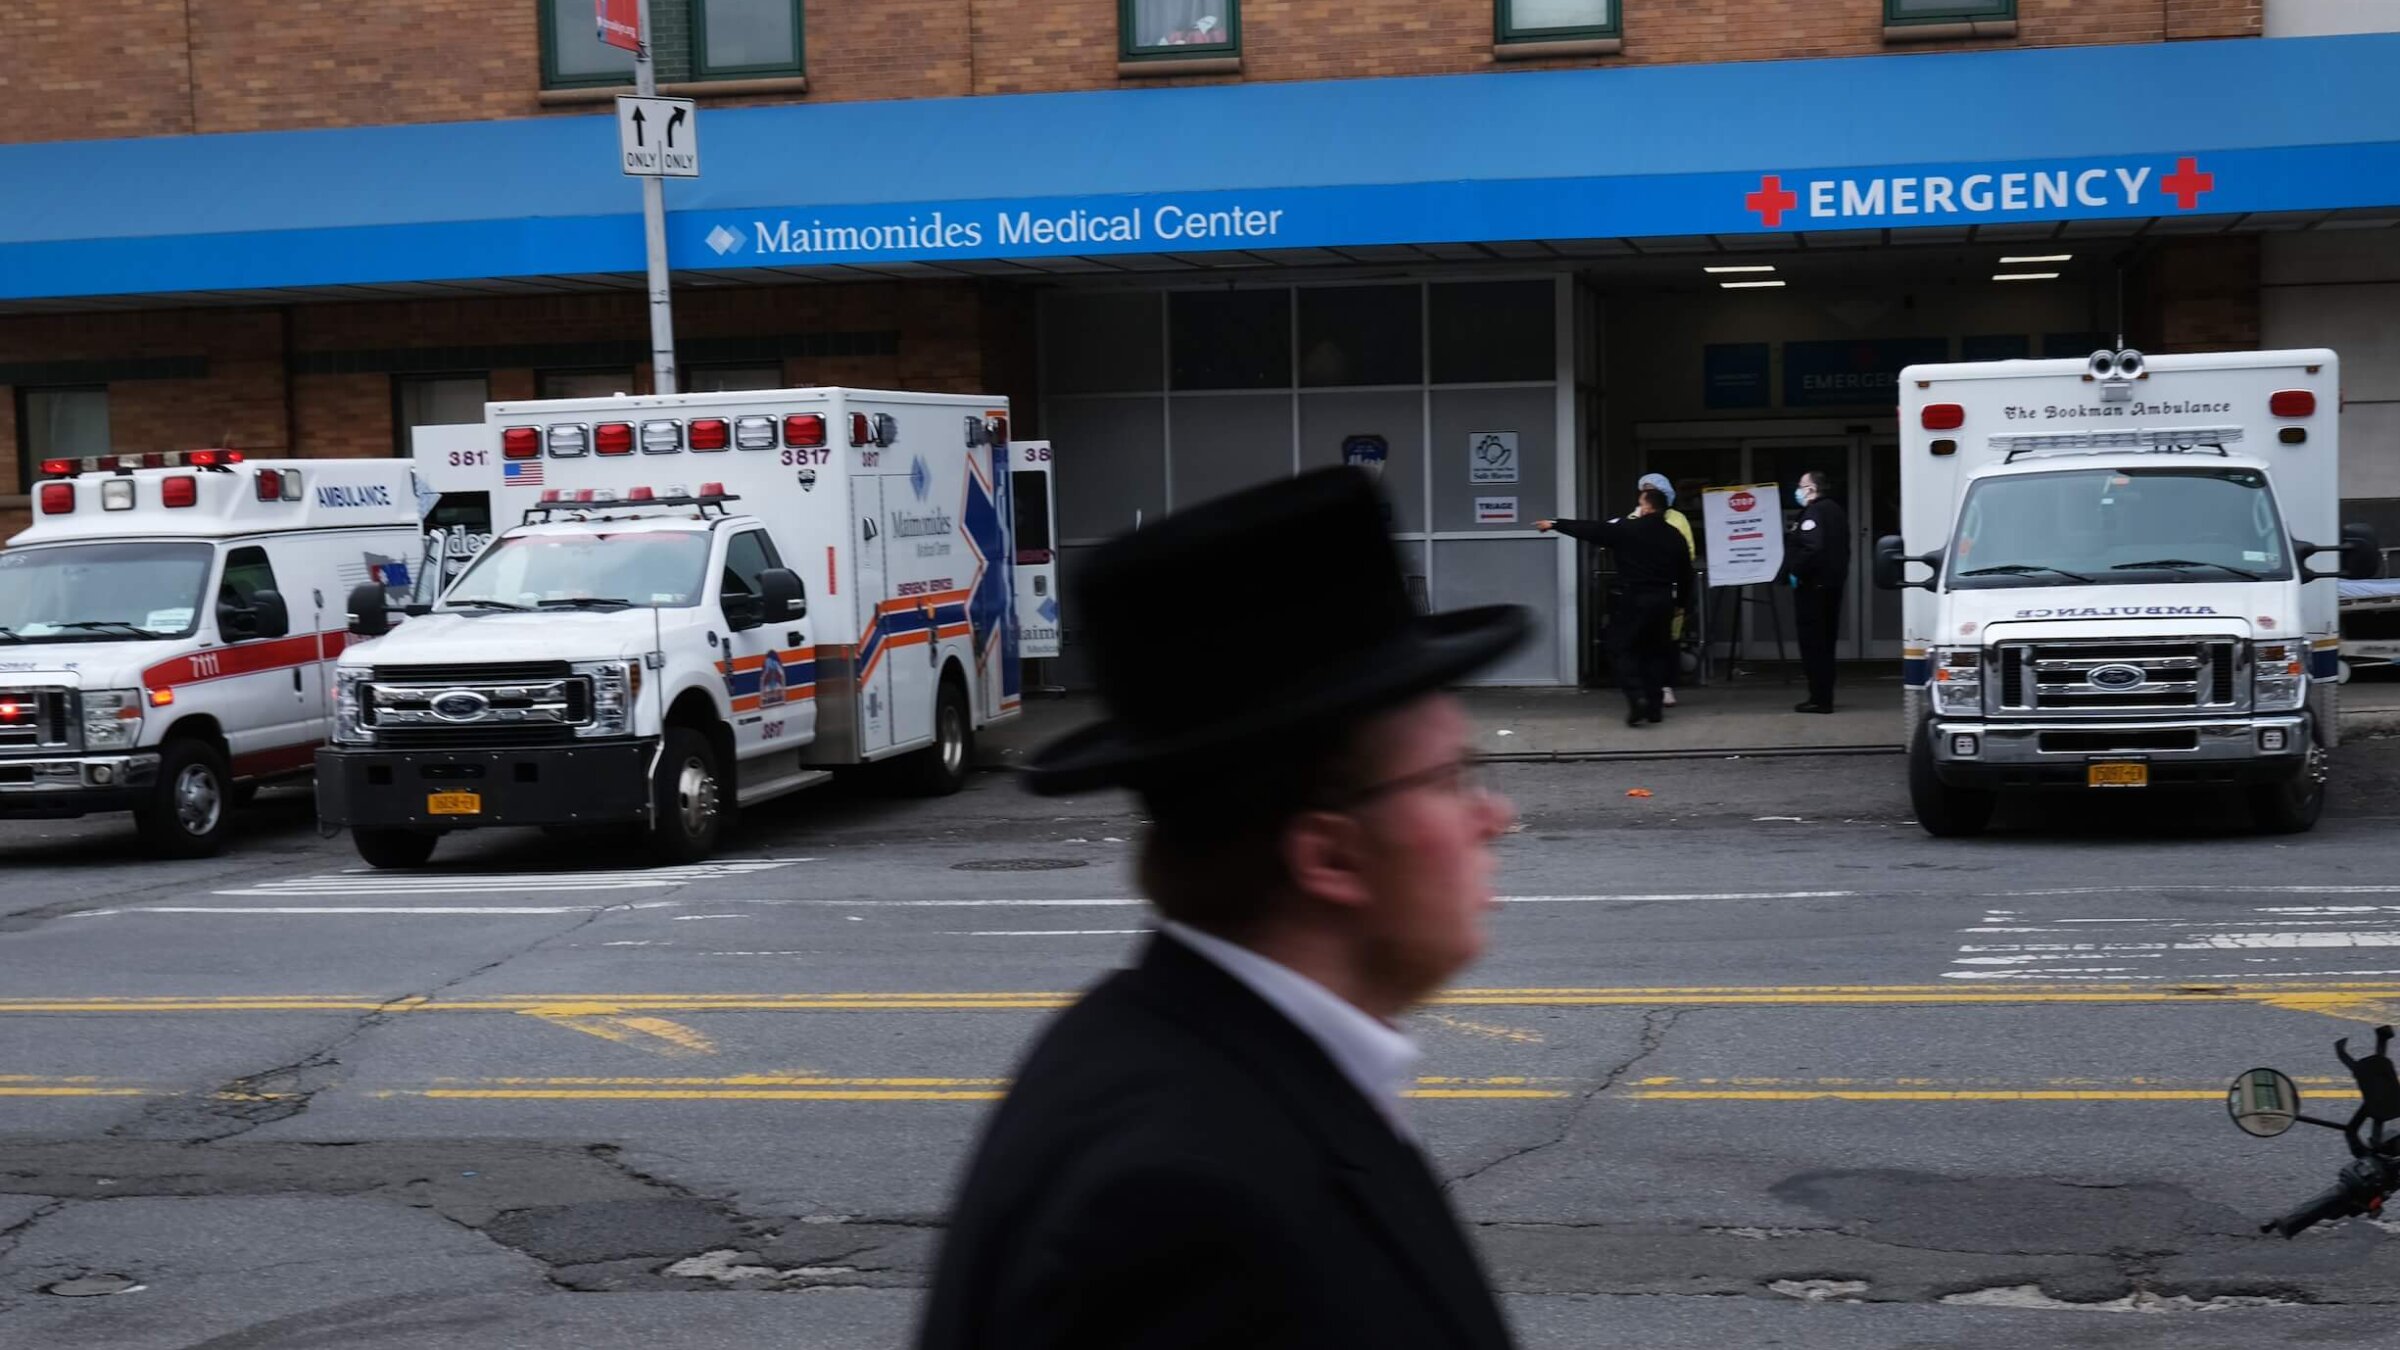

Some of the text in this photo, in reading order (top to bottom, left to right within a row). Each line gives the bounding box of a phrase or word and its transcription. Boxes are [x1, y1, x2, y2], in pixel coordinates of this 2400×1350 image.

[626, 153, 657, 168] ONLY
[665, 154, 694, 169] ONLY
[1810, 166, 2151, 218] EMERGENCY
[754, 204, 1283, 255] Maimonides Medical Center
[2004, 400, 2231, 420] The Bookman Ambulance
[448, 450, 489, 467] 381
[781, 448, 831, 466] 3817
[316, 484, 392, 508] AMBULANCE
[1478, 502, 1513, 510] TRIAGE
[1729, 497, 1755, 507] STOP
[891, 506, 951, 538] Maimonides
[188, 652, 220, 678] 7111
[762, 720, 785, 740] 3817
